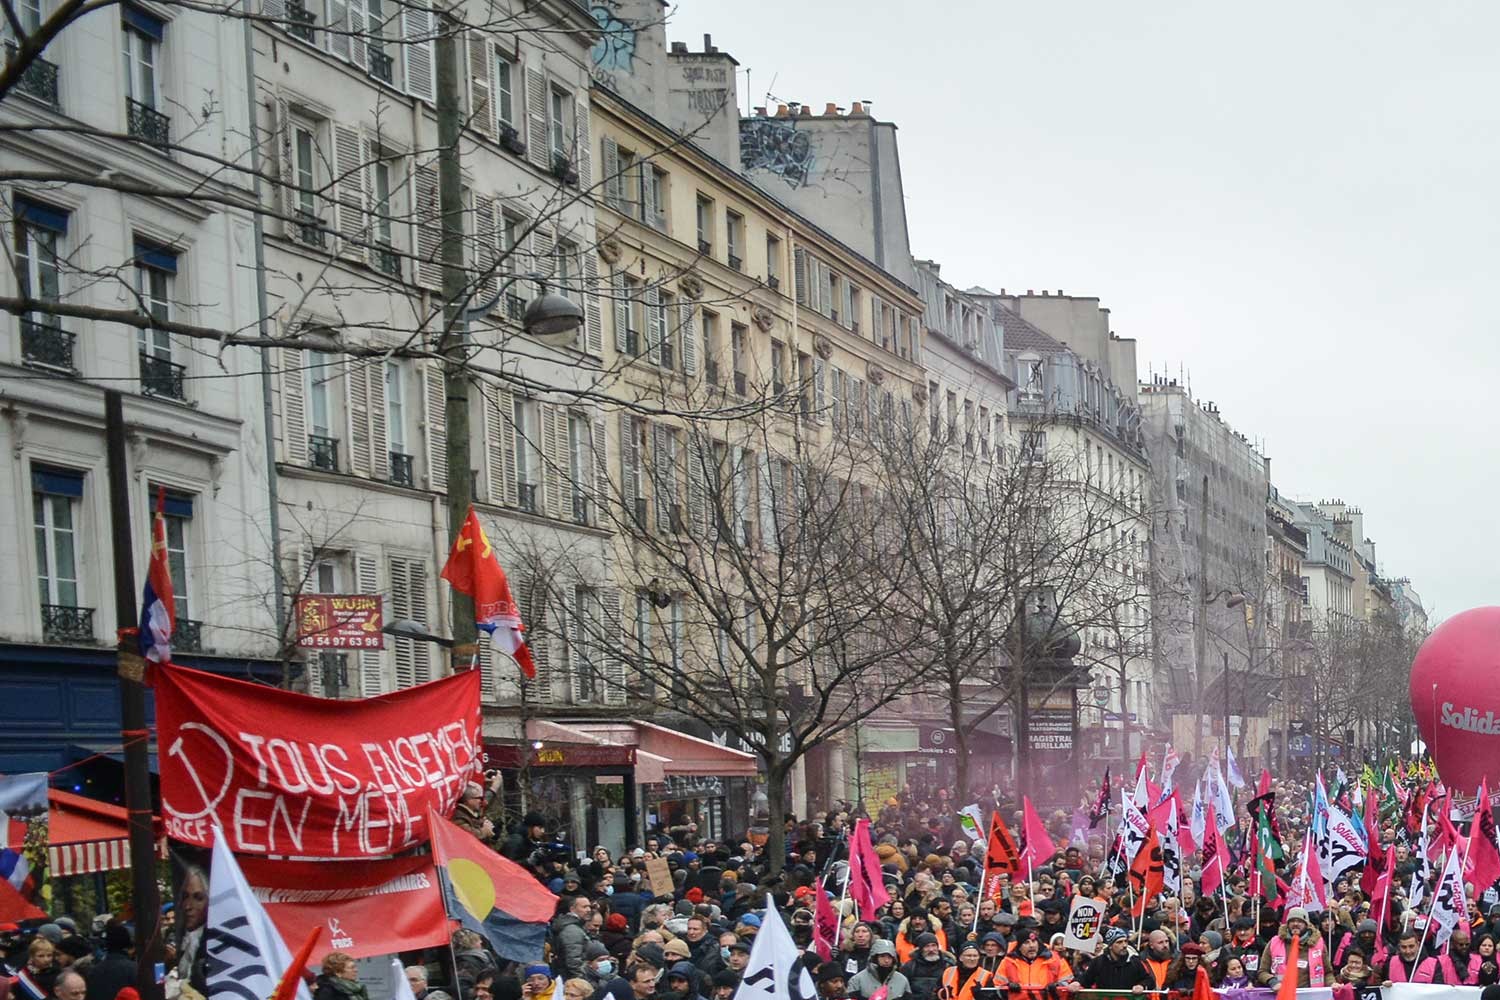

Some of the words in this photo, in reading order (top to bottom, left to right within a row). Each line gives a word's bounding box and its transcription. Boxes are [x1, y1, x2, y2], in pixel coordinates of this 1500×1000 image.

[332, 598, 376, 610] WUJIN
[301, 637, 313, 645] 09
[317, 637, 330, 645] 54
[333, 637, 345, 645] 97
[349, 637, 362, 646] 63
[365, 638, 378, 646] 96
[240, 731, 362, 796] TOUS
[233, 787, 312, 852] EN
[1077, 906, 1093, 917] NON
[1076, 923, 1090, 938] 64
